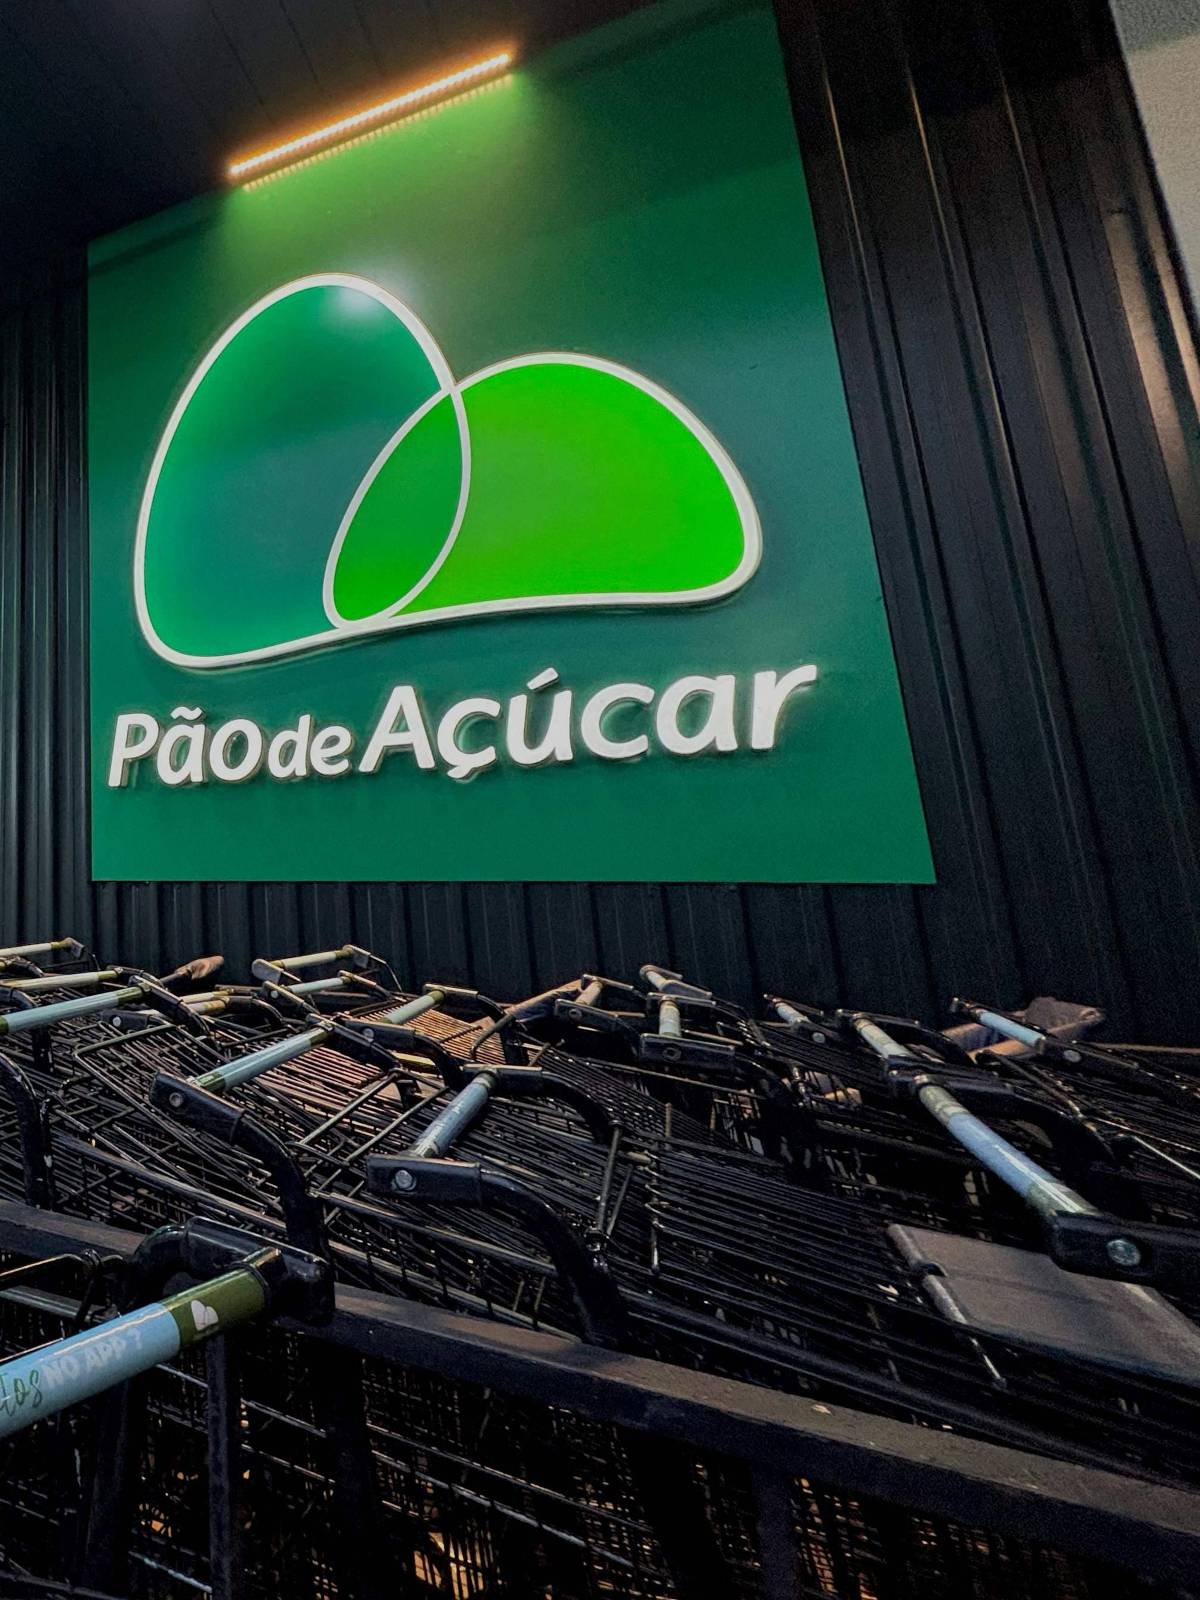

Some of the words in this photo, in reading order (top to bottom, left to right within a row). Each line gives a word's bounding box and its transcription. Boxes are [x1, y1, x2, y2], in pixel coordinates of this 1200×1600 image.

[107, 705, 264, 788] Pão
[266, 713, 352, 779] de
[358, 664, 818, 780] Açúcar
[40, 1355, 78, 1388] NO
[86, 1335, 128, 1372] APP
